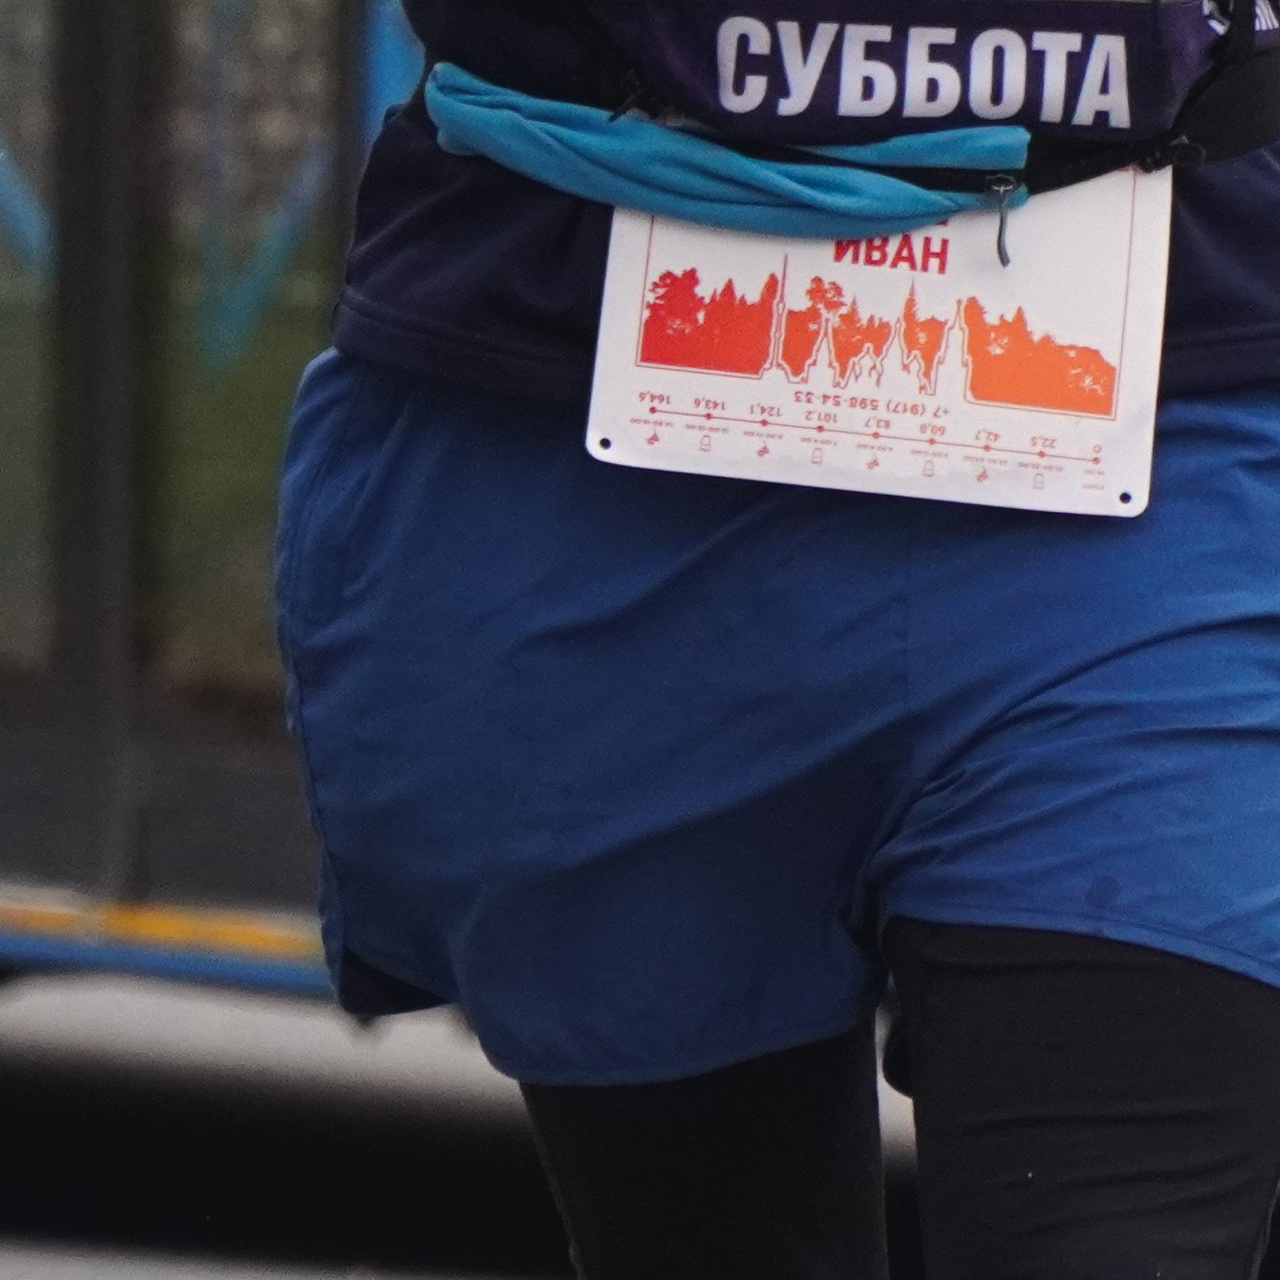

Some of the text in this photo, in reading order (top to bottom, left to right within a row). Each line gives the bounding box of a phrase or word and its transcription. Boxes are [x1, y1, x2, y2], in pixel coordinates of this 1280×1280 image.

[715, 15, 1132, 129] СУББОТА
[833, 233, 950, 275] ИВАН
[693, 396, 727, 411] 143,6
[749, 403, 783, 418] 124,1
